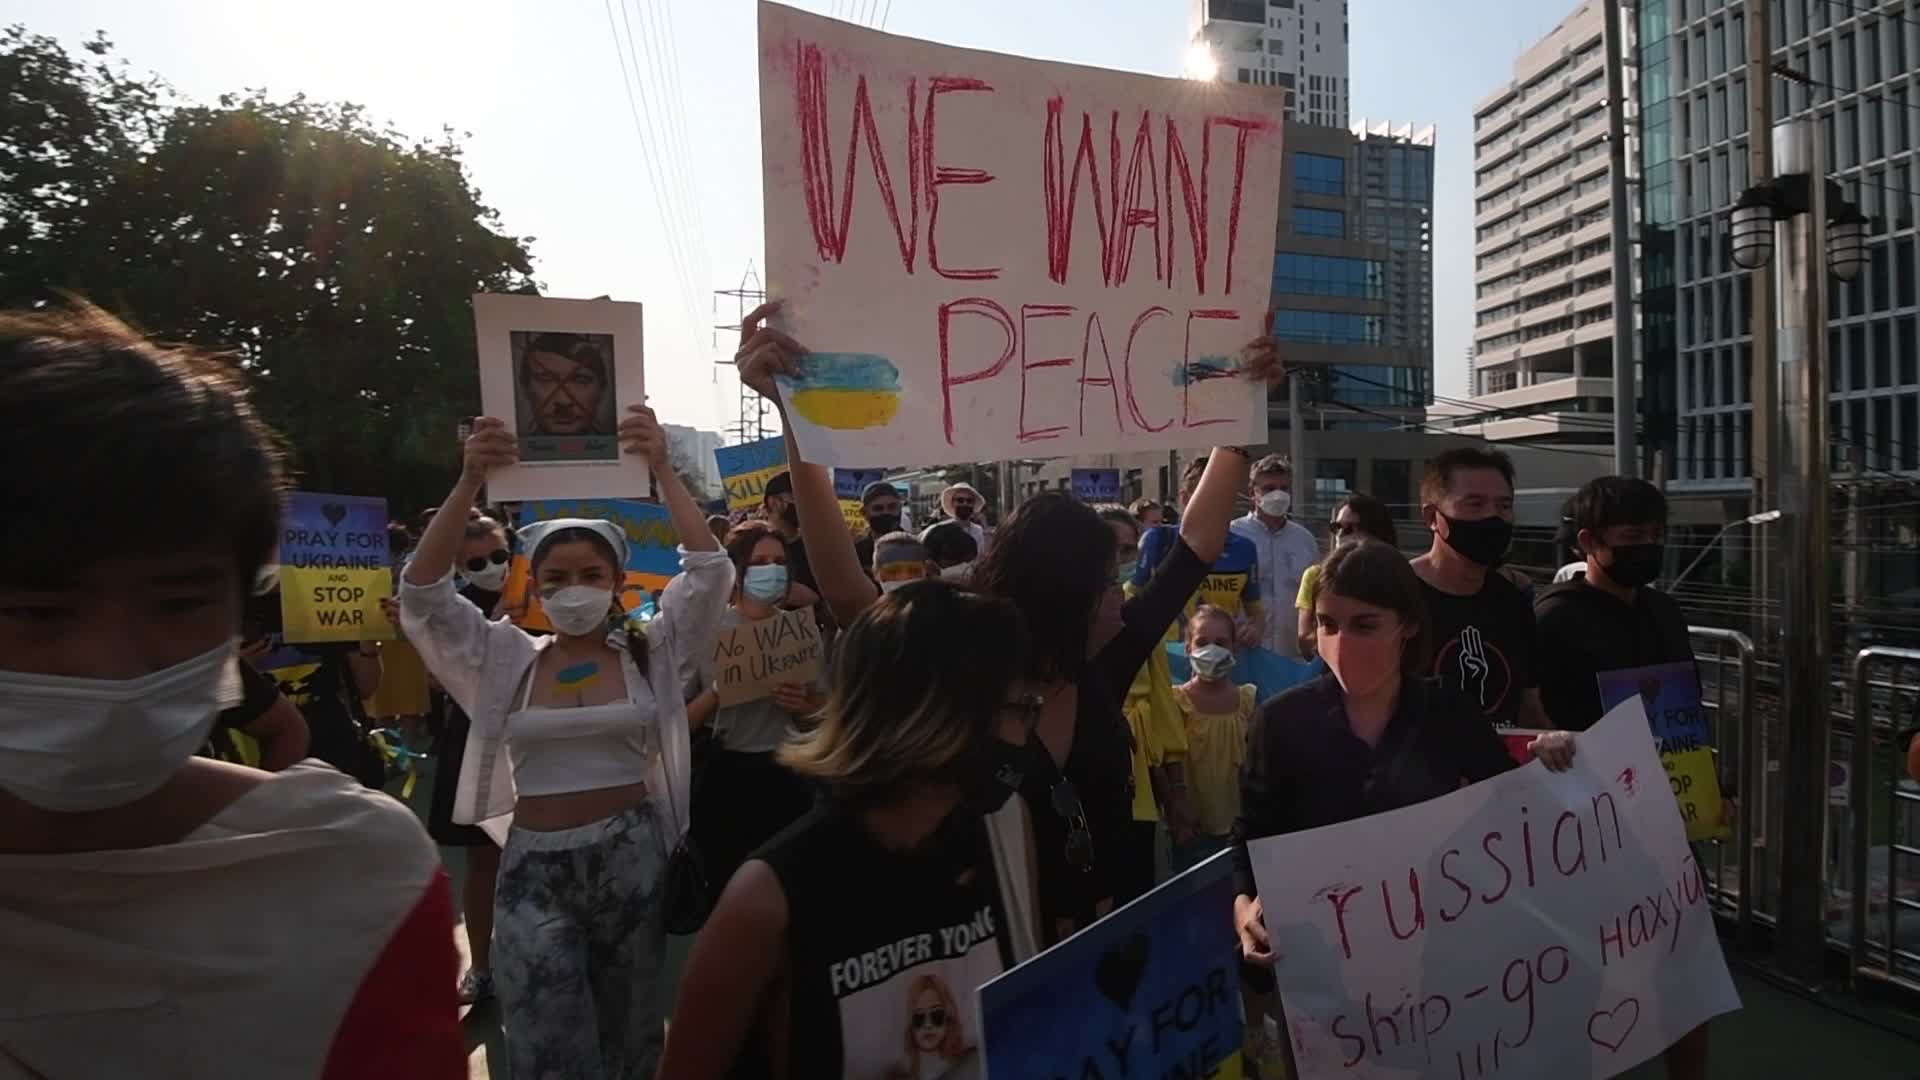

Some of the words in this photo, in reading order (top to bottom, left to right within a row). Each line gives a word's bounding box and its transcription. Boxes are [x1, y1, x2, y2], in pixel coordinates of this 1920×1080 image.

[797, 38, 1000, 281] WE
[1044, 95, 1264, 296] WANT
[938, 297, 1243, 446] PEACE
[286, 529, 338, 547] PRAY
[345, 532, 384, 548] FOR
[293, 553, 380, 570] UKRAINE
[328, 574, 348, 582] AND
[1201, 578, 1238, 592] AINE
[314, 586, 364, 602] STOP
[316, 609, 364, 625] WAR
[753, 610, 813, 652] WAR
[723, 664, 742, 684] in
[1669, 775, 1692, 795] OP
[1320, 790, 1622, 959] russian
[829, 933, 933, 996] FOREVER
[1152, 968, 1231, 1054] FOR
